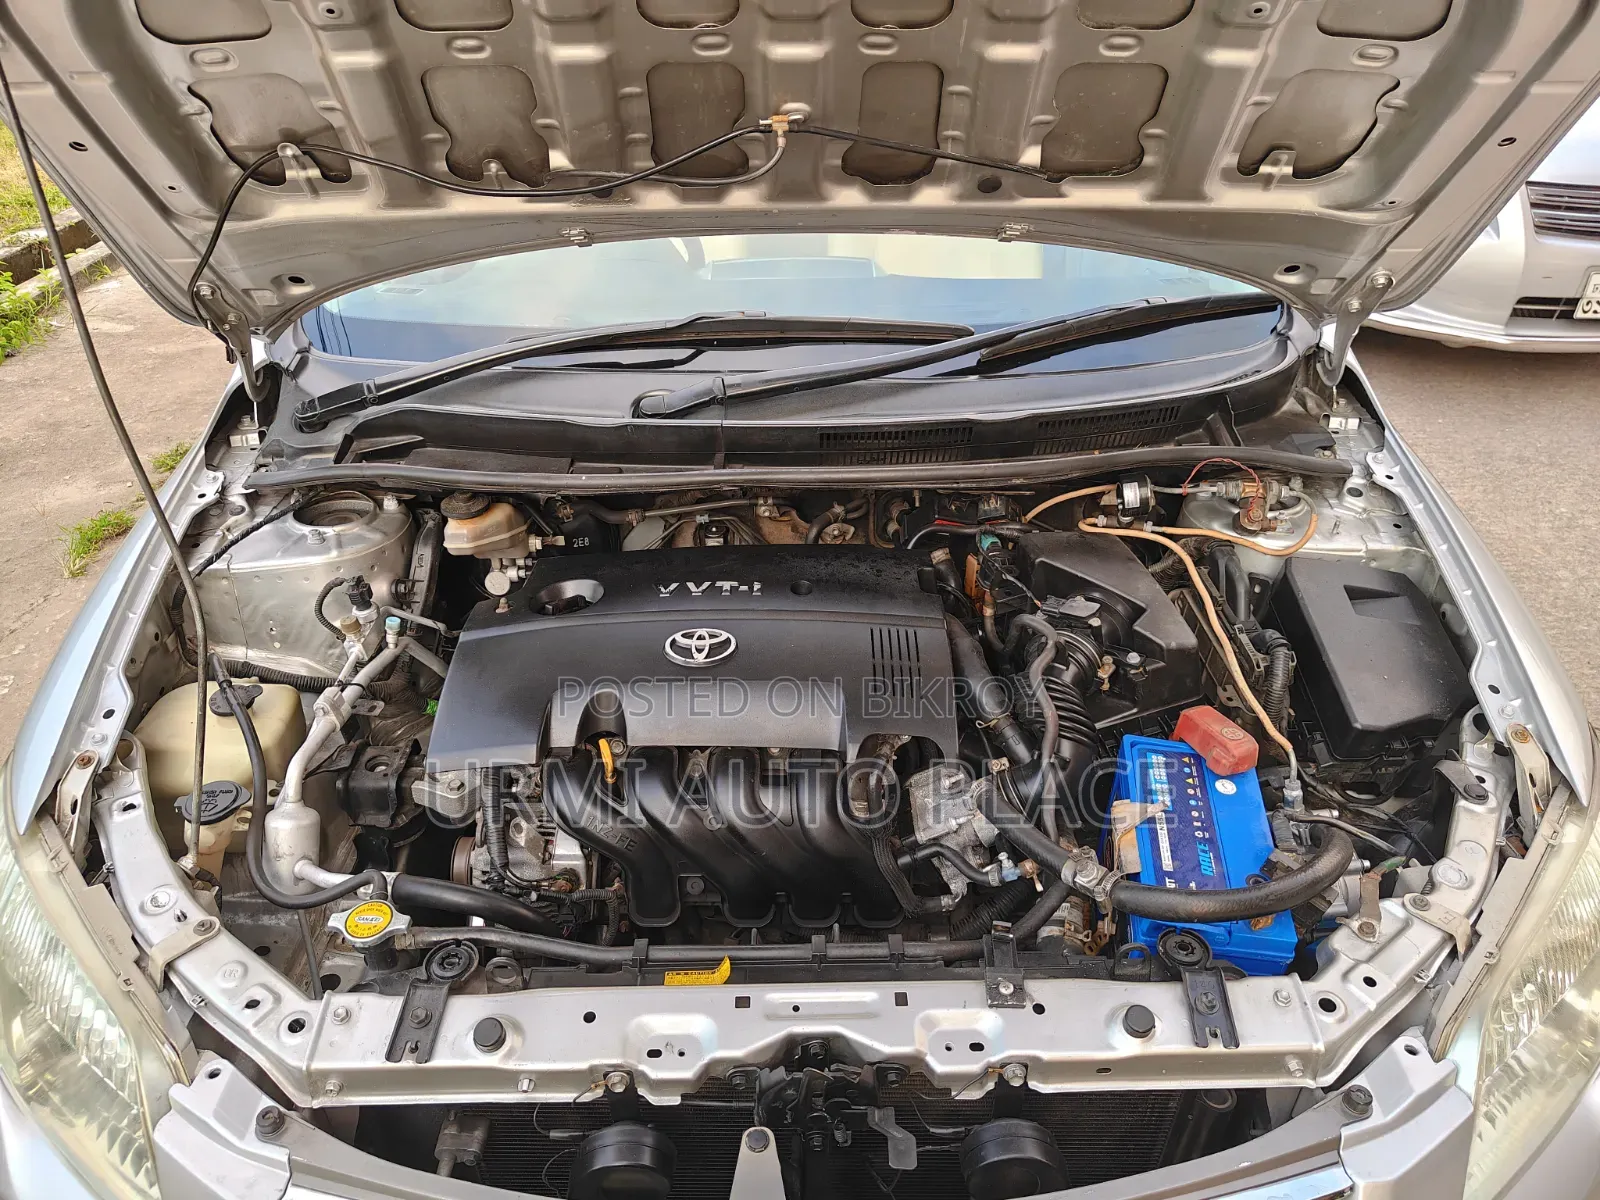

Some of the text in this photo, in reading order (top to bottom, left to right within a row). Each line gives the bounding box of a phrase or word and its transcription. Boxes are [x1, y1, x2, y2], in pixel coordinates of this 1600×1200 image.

[572, 536, 590, 548] 2E8
[586, 816, 638, 853] 1NZ-FE
[1196, 841, 1213, 876] RACE
